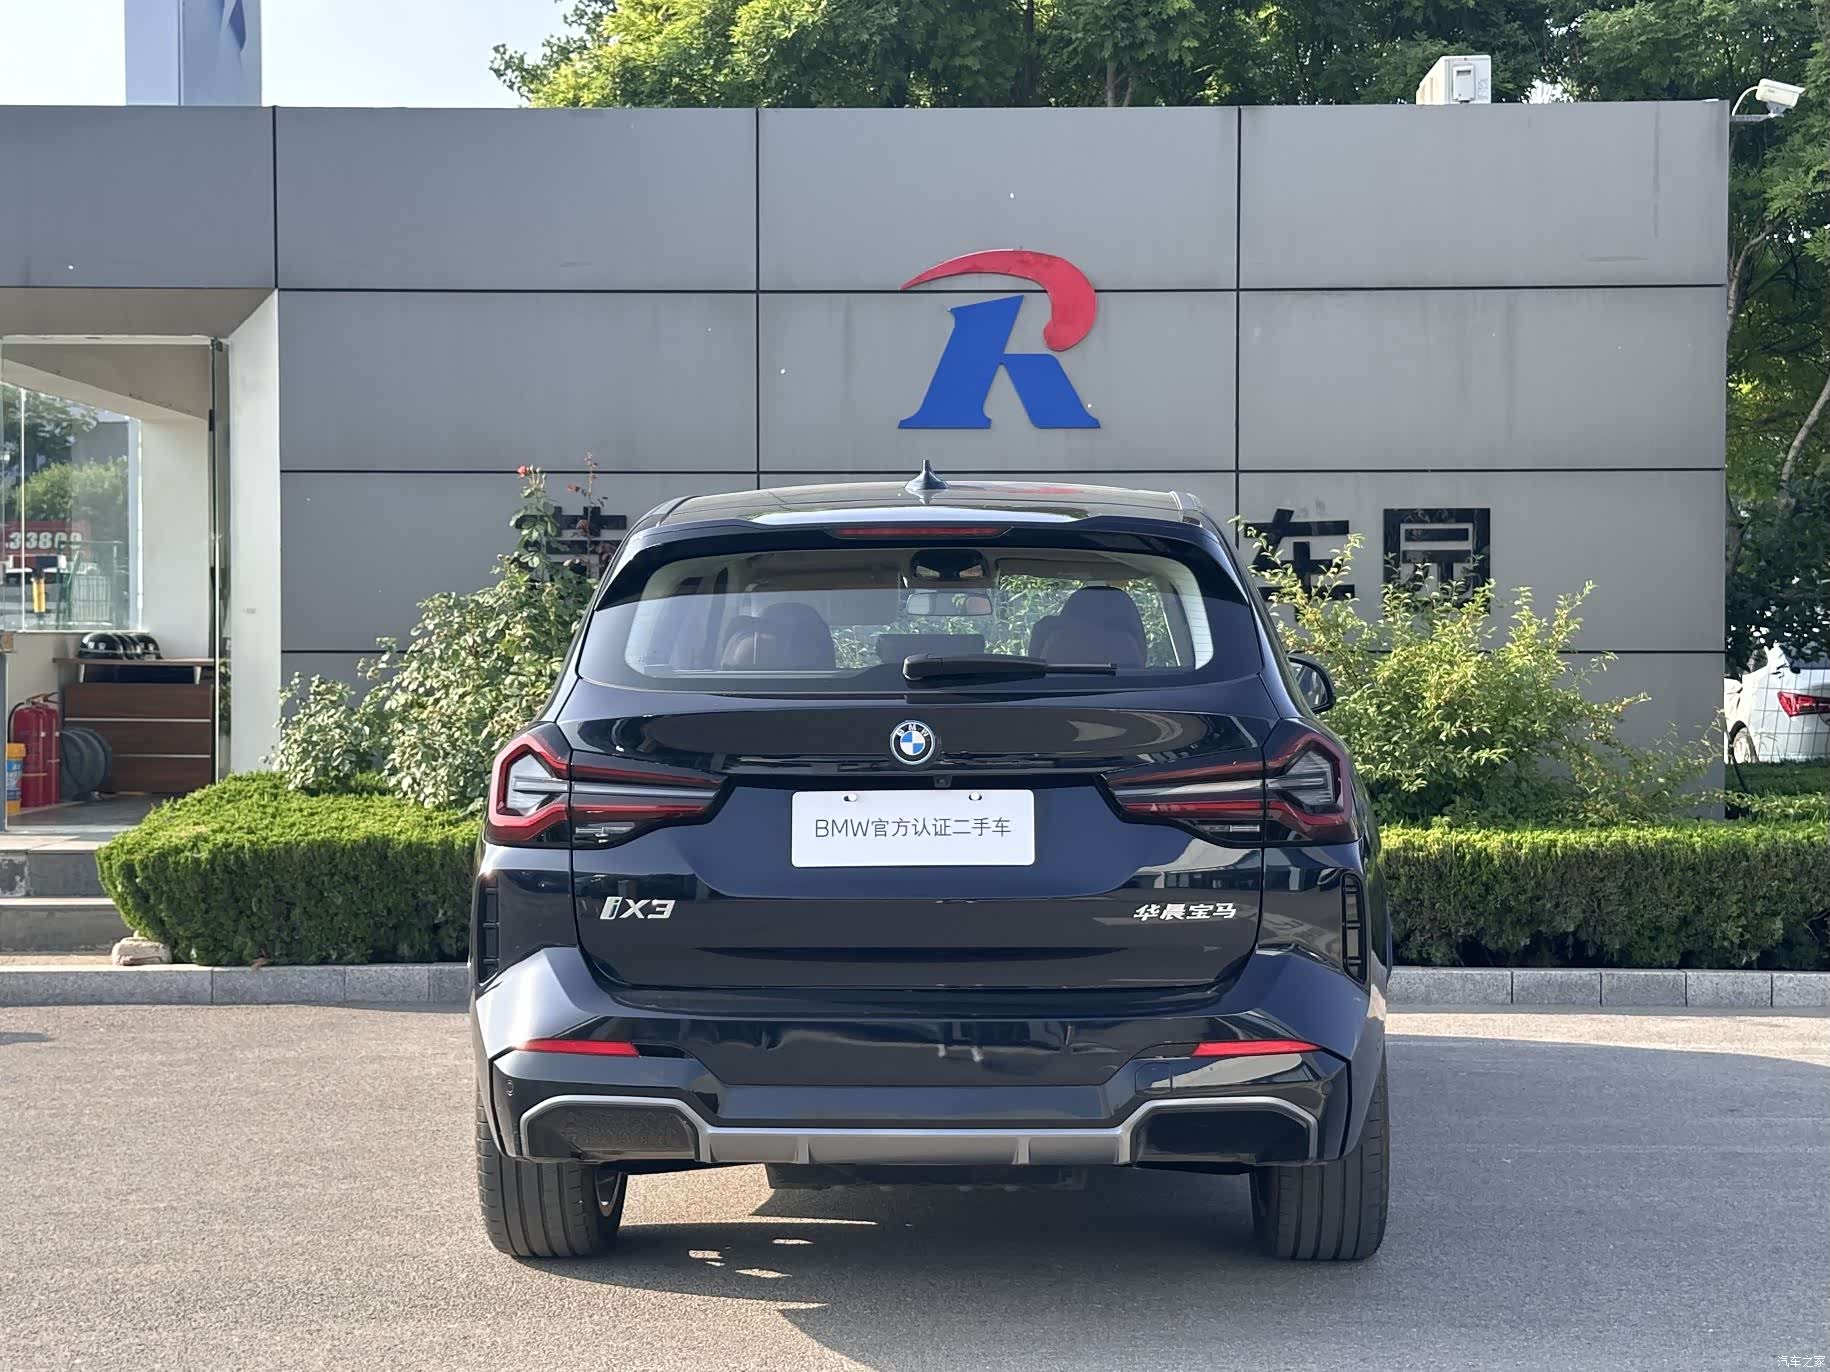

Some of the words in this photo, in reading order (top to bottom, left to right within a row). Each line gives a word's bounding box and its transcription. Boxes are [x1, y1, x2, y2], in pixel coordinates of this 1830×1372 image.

[896, 723, 930, 737] BMW
[814, 817, 1012, 838] BMW官方认证二手车
[600, 896, 676, 920] iX3
[1133, 902, 1237, 922] 华晨宝马
